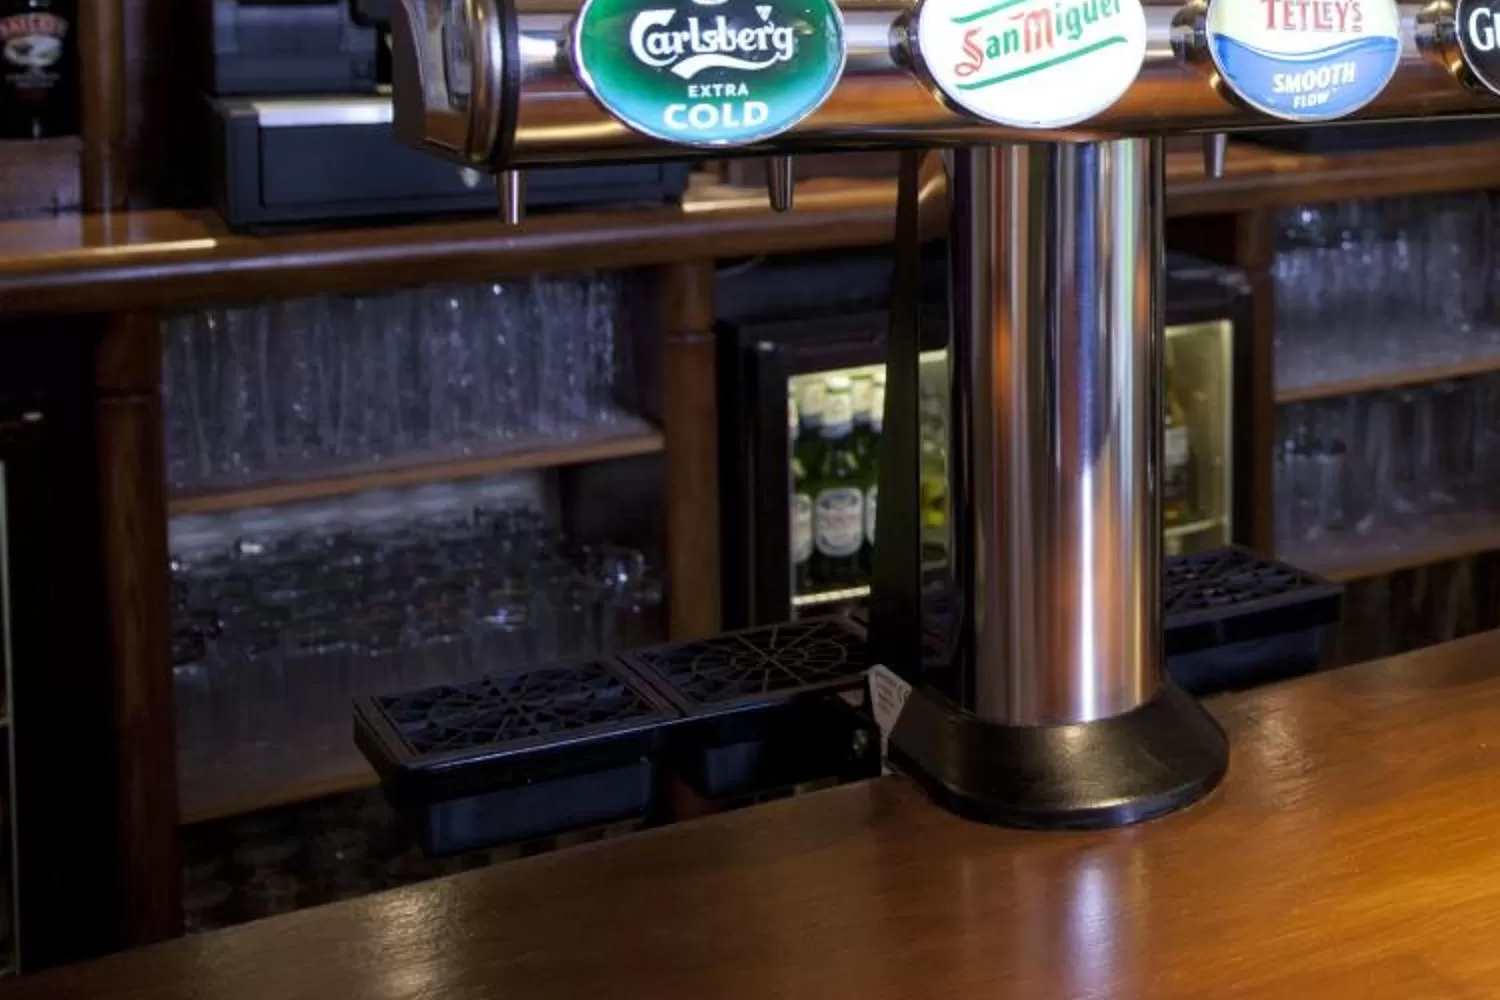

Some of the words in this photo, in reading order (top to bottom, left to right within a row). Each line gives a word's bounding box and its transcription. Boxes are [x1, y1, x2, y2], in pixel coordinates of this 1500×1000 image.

[629, 4, 795, 80] Carlsberg
[954, 26, 1020, 77] San
[687, 82, 750, 99] EXTRA
[1272, 60, 1357, 94] SMOOTH
[663, 101, 770, 131] COLD
[1293, 90, 1330, 110] FLOW
